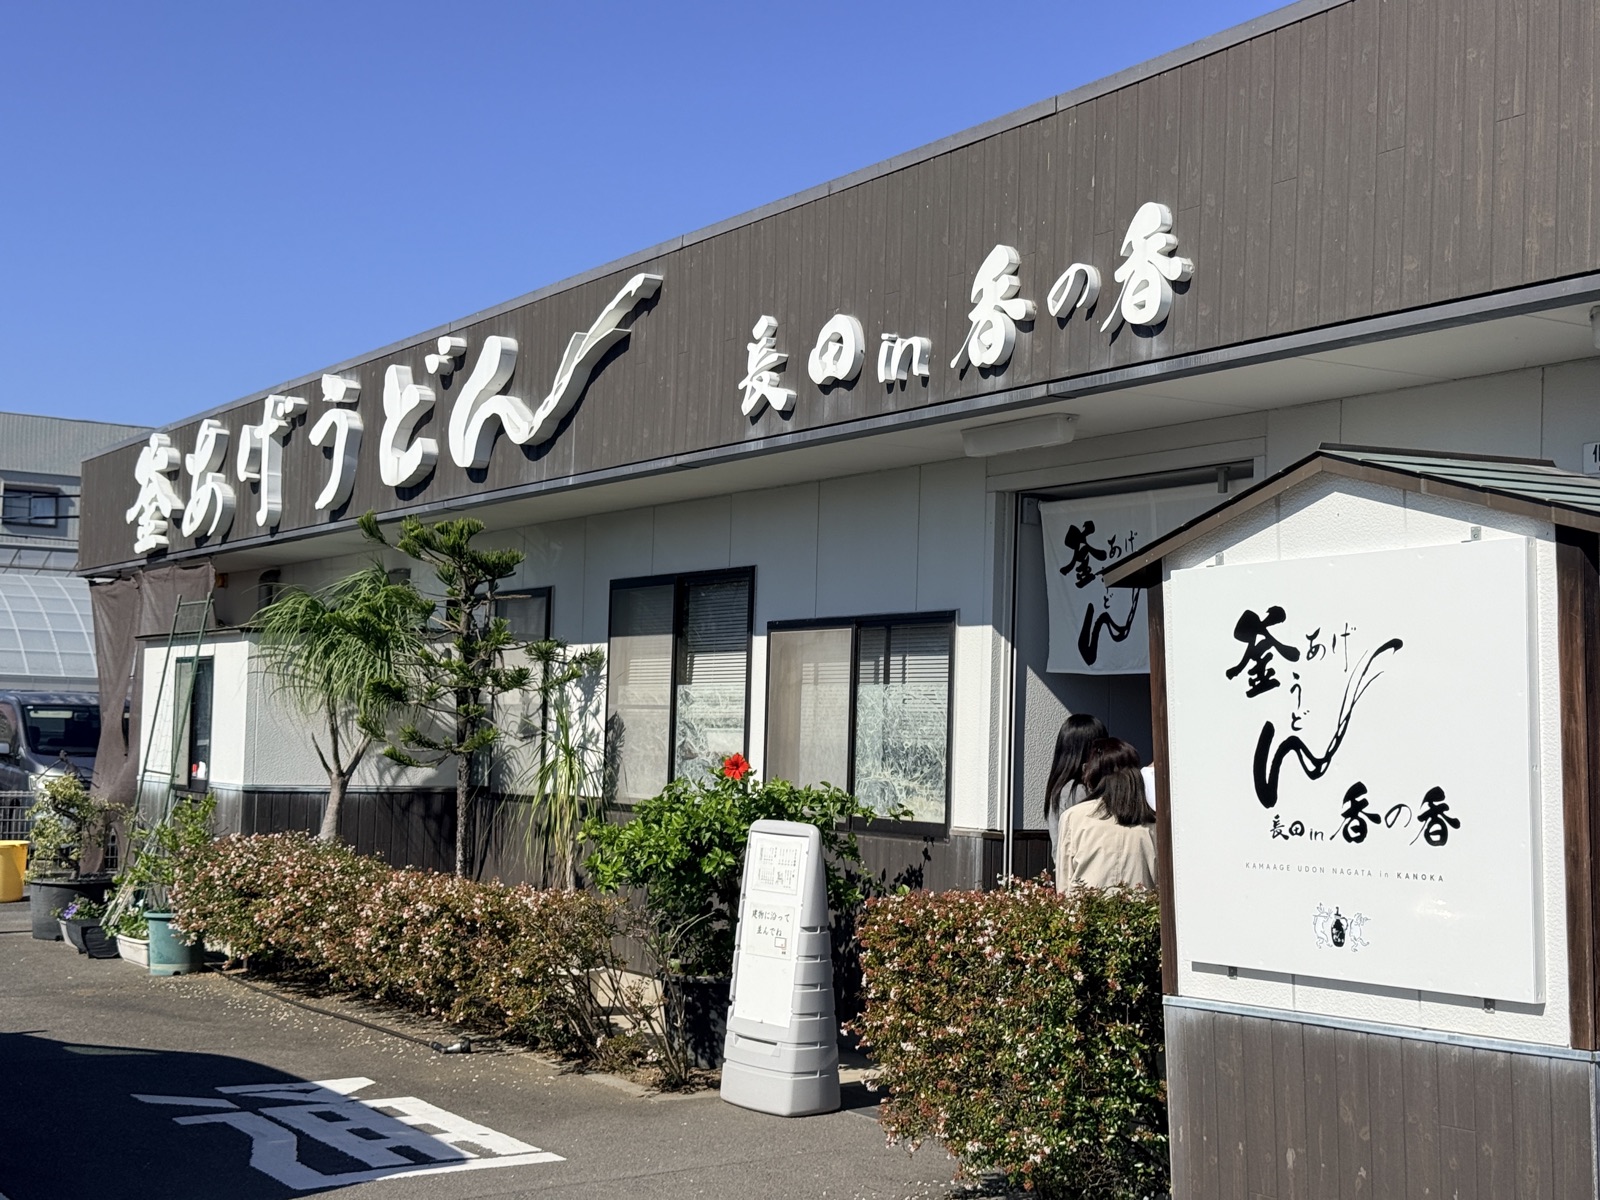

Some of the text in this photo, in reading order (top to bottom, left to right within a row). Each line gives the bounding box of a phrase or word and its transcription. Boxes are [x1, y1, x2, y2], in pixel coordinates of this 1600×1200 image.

[126, 272, 664, 555] 釜あげうどん
[1245, 862, 1444, 882] KAMAAGE UDON NAGATA in KANOKA
[752, 909, 790, 923] 建物に沿って
